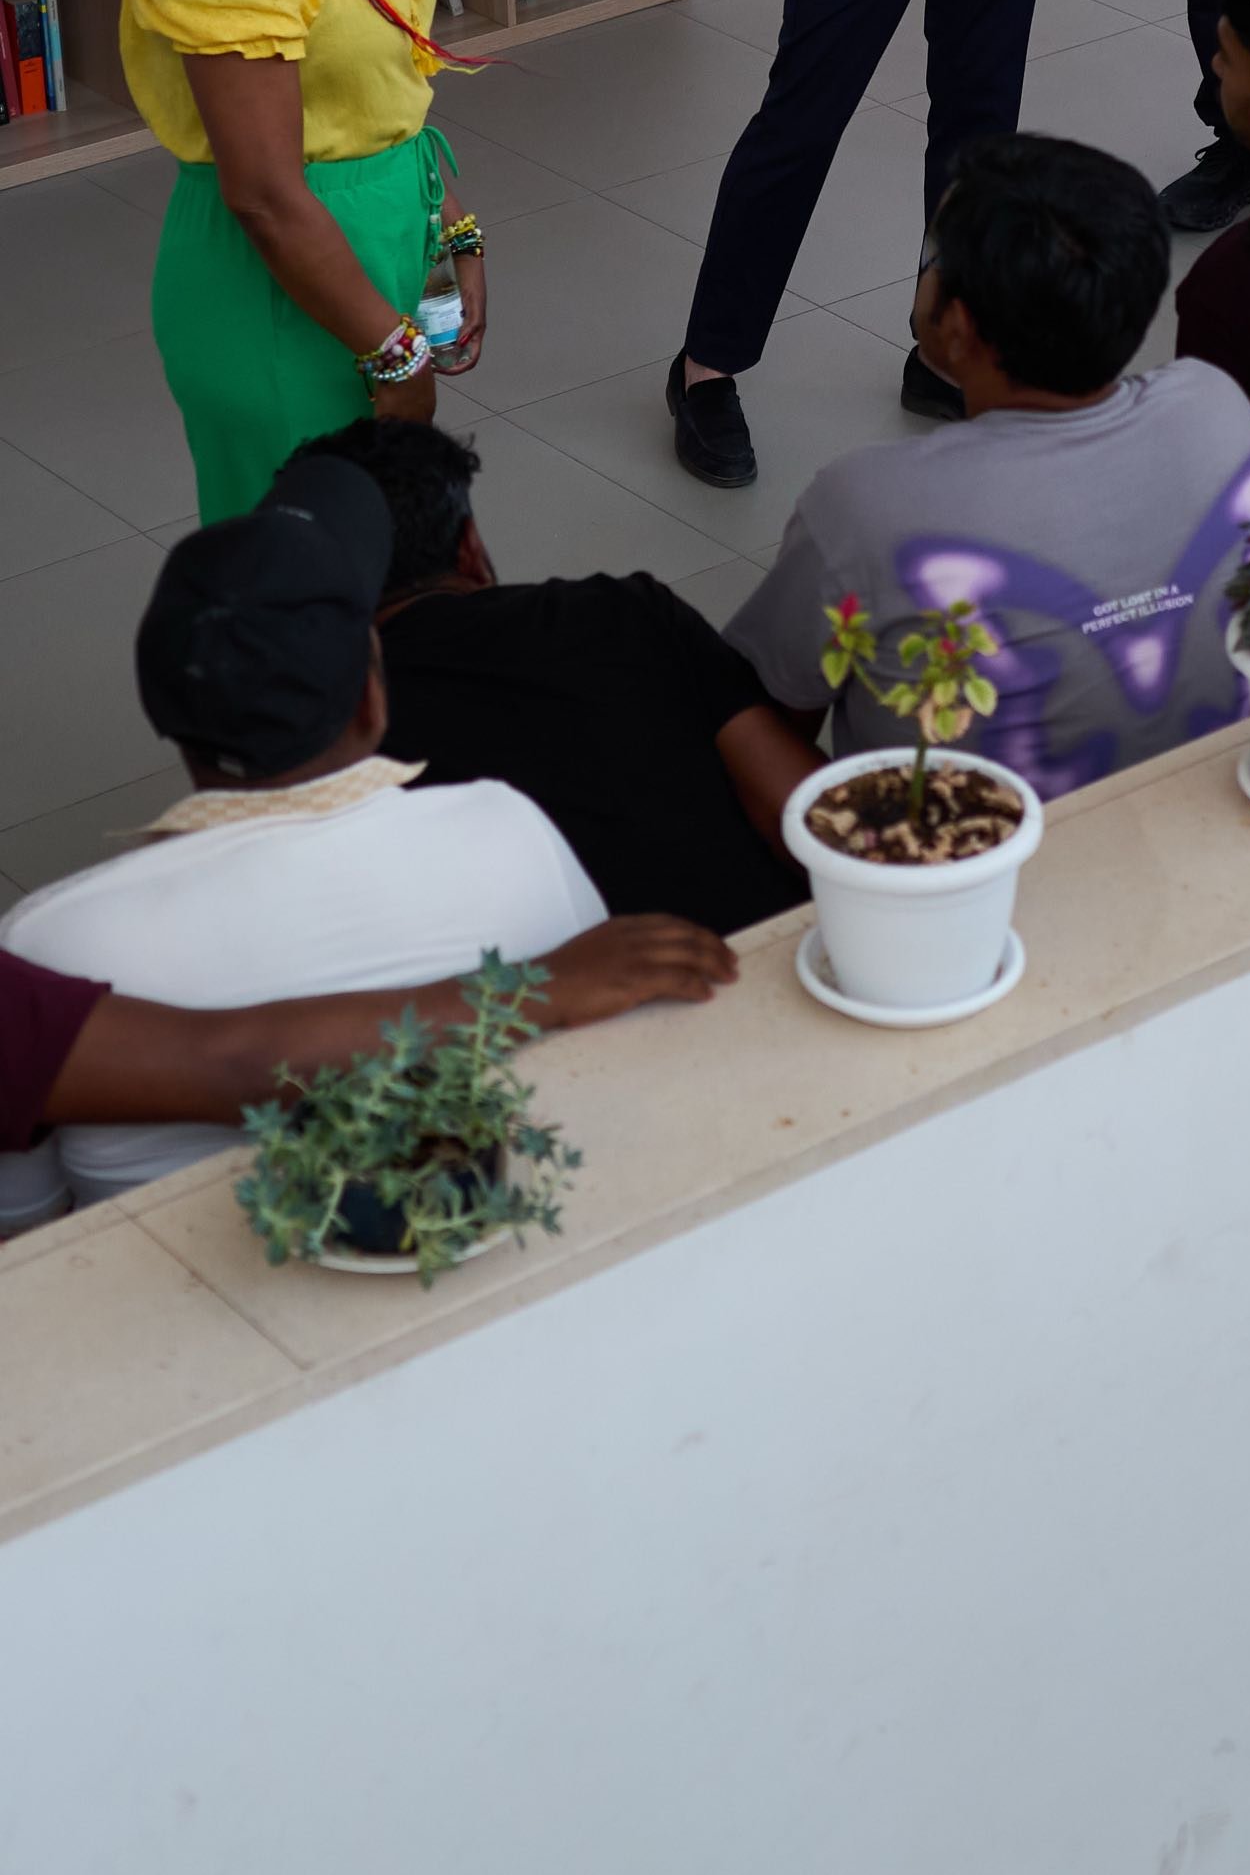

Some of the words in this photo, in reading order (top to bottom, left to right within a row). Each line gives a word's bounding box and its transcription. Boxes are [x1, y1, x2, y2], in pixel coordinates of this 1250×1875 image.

[1081, 609, 1137, 635] PERFECT
[1138, 593, 1195, 619] ILLUSION
[1093, 601, 1118, 617] GOT
[1120, 591, 1152, 611] LOST
[1153, 586, 1170, 599] IN
[1170, 583, 1180, 595] A
